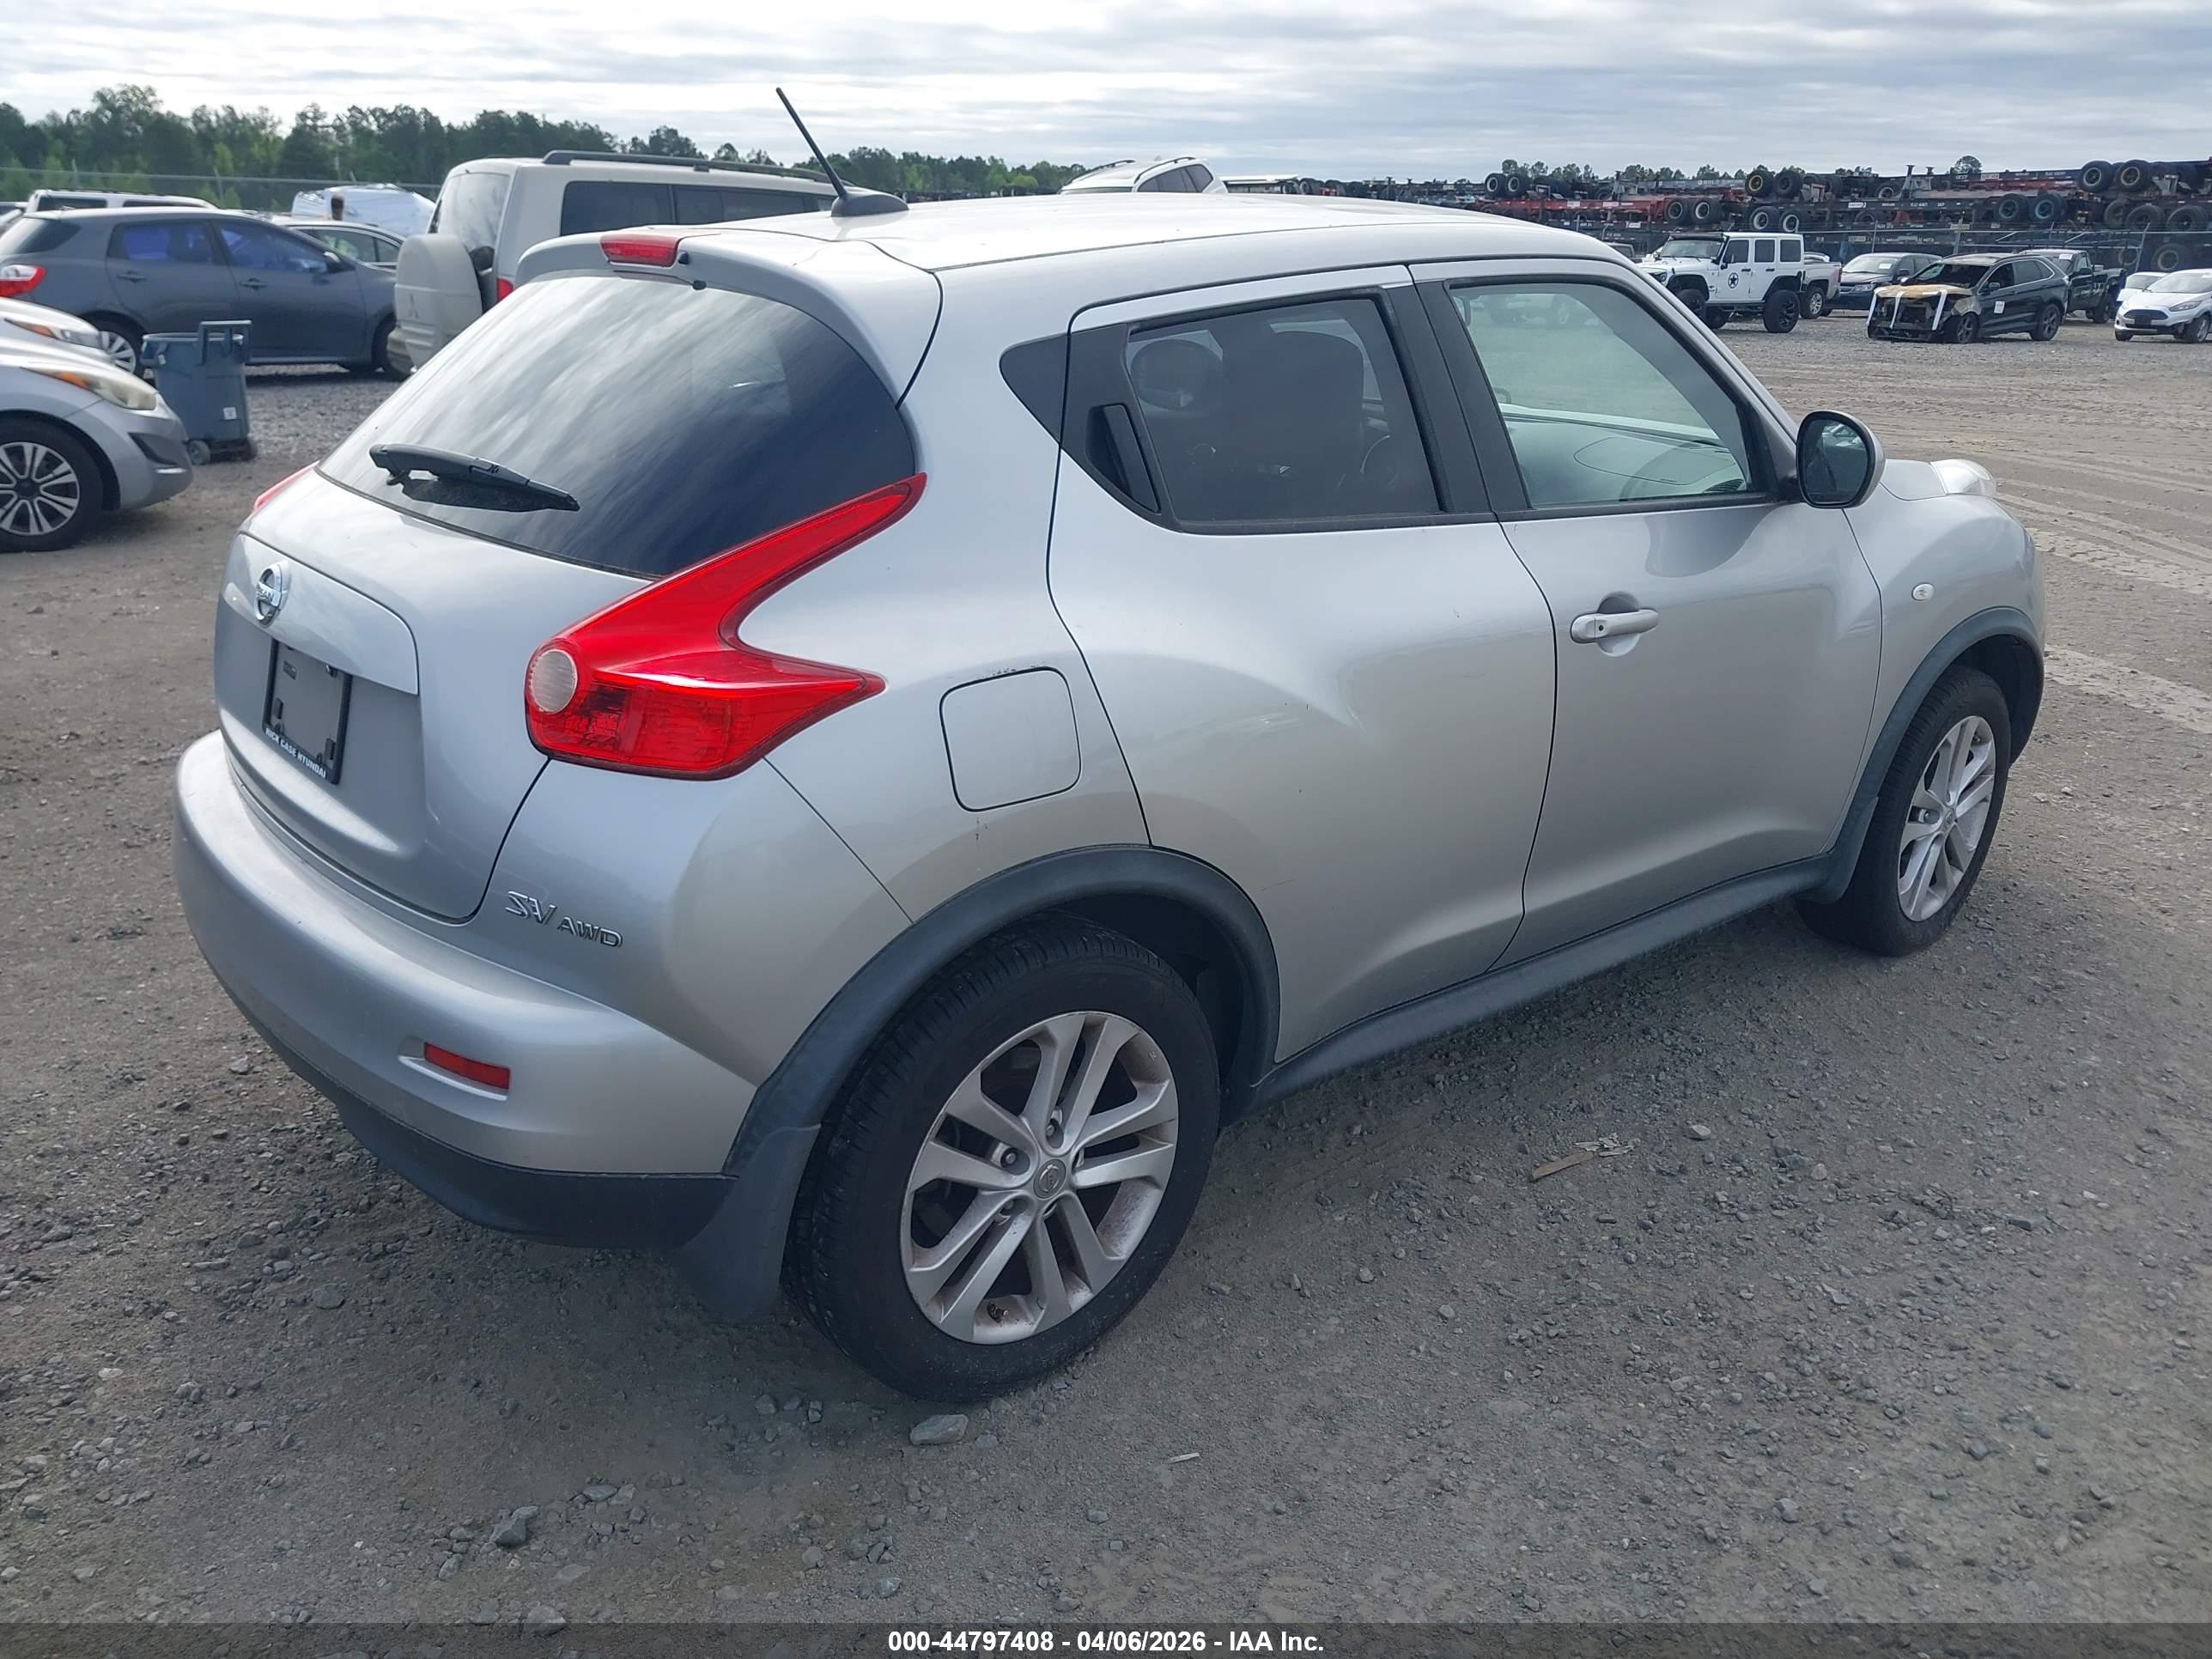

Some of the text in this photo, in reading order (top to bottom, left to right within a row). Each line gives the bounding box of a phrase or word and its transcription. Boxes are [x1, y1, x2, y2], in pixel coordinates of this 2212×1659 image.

[265, 728, 327, 779] RICK CASE HYUNDAI
[505, 890, 623, 947] SV AWD
